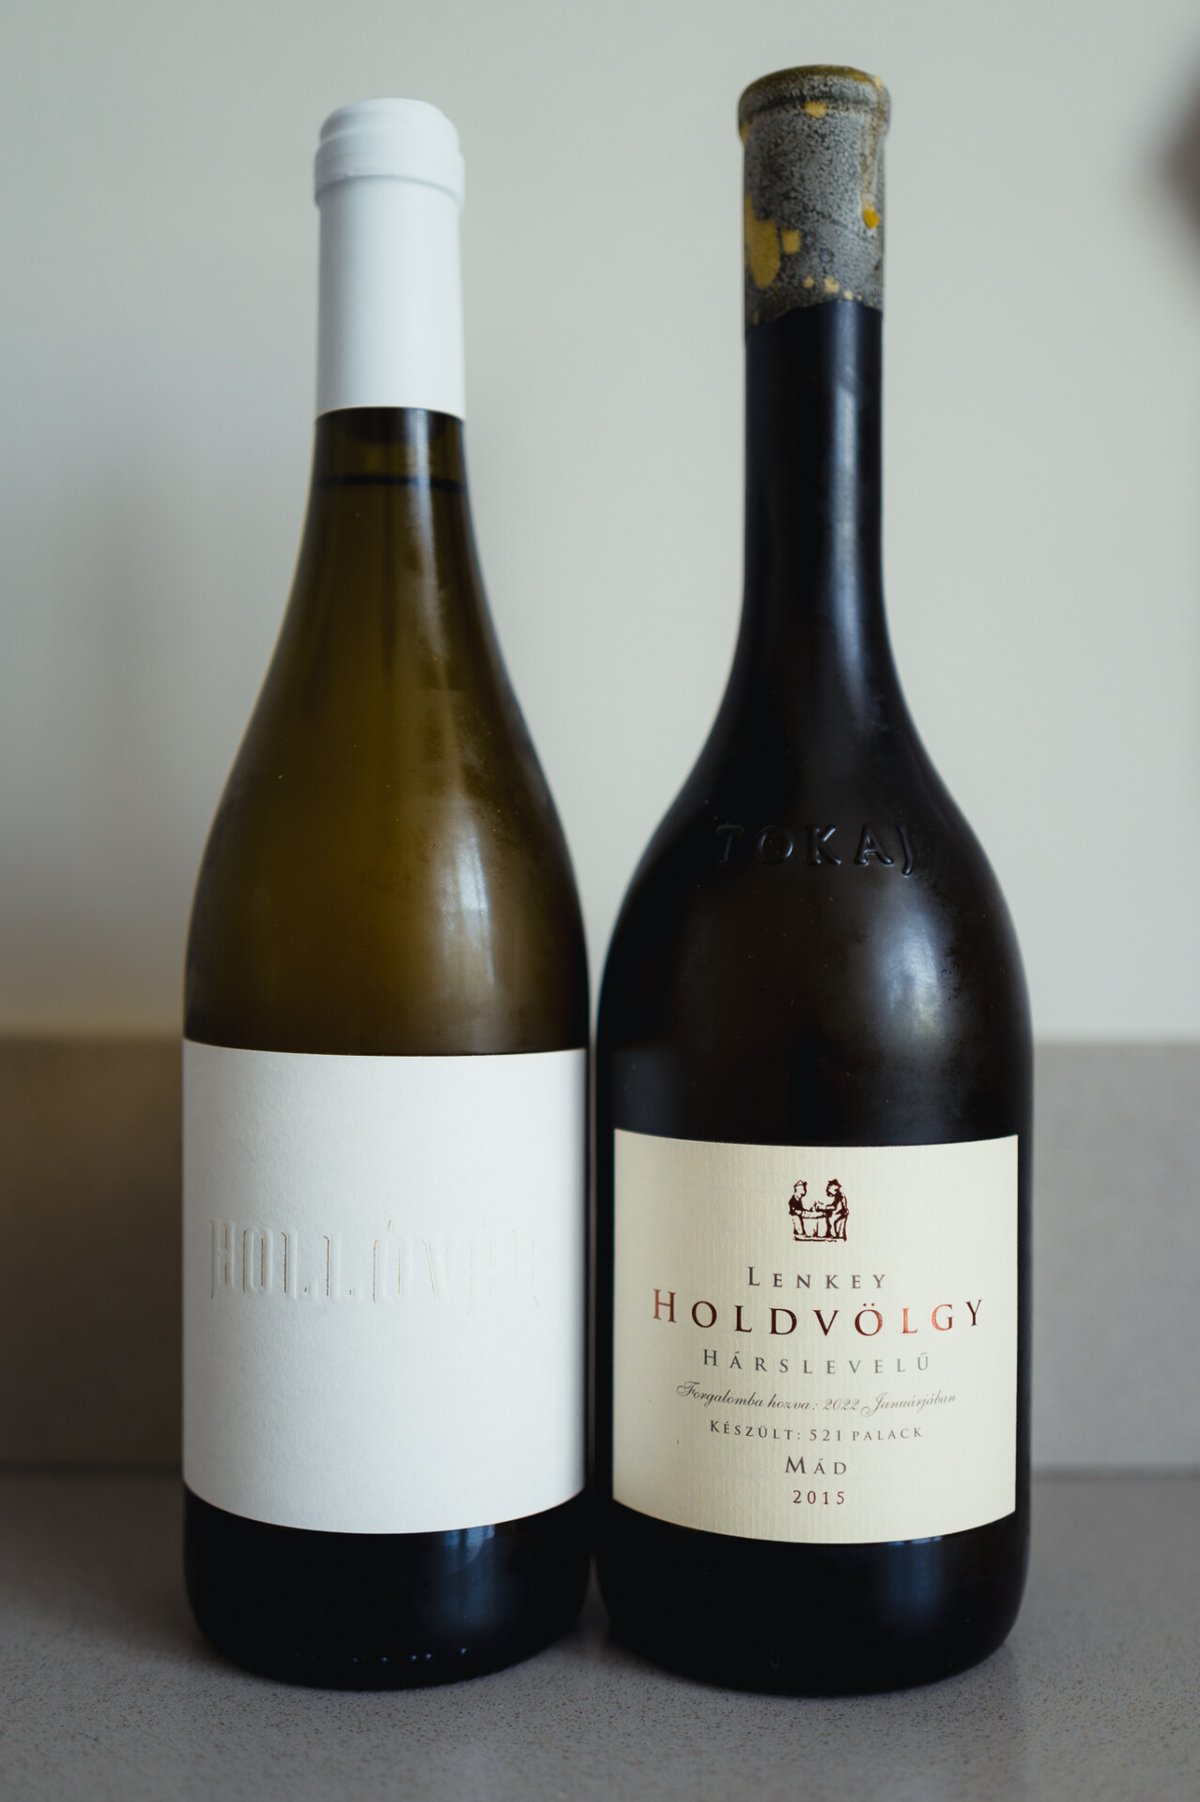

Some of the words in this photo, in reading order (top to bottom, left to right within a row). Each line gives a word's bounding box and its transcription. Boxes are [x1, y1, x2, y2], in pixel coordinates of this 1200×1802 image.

[715, 824, 915, 877] TOKAJ
[747, 1266, 887, 1290] LENKEY
[652, 1288, 983, 1336] HOLDVÖLGY
[703, 1349, 930, 1374] HÁRSLEVELŰ
[676, 1380, 765, 1409] Forgalomba
[766, 1393, 818, 1411] hozva:
[823, 1397, 859, 1412] 2022
[861, 1391, 956, 1417] Januárjában
[709, 1420, 801, 1440] KÉSZÜLT:
[809, 1429, 843, 1441] 521
[852, 1427, 922, 1441] PALACK
[785, 1456, 848, 1475] MÁD
[792, 1489, 846, 1505] 2015
